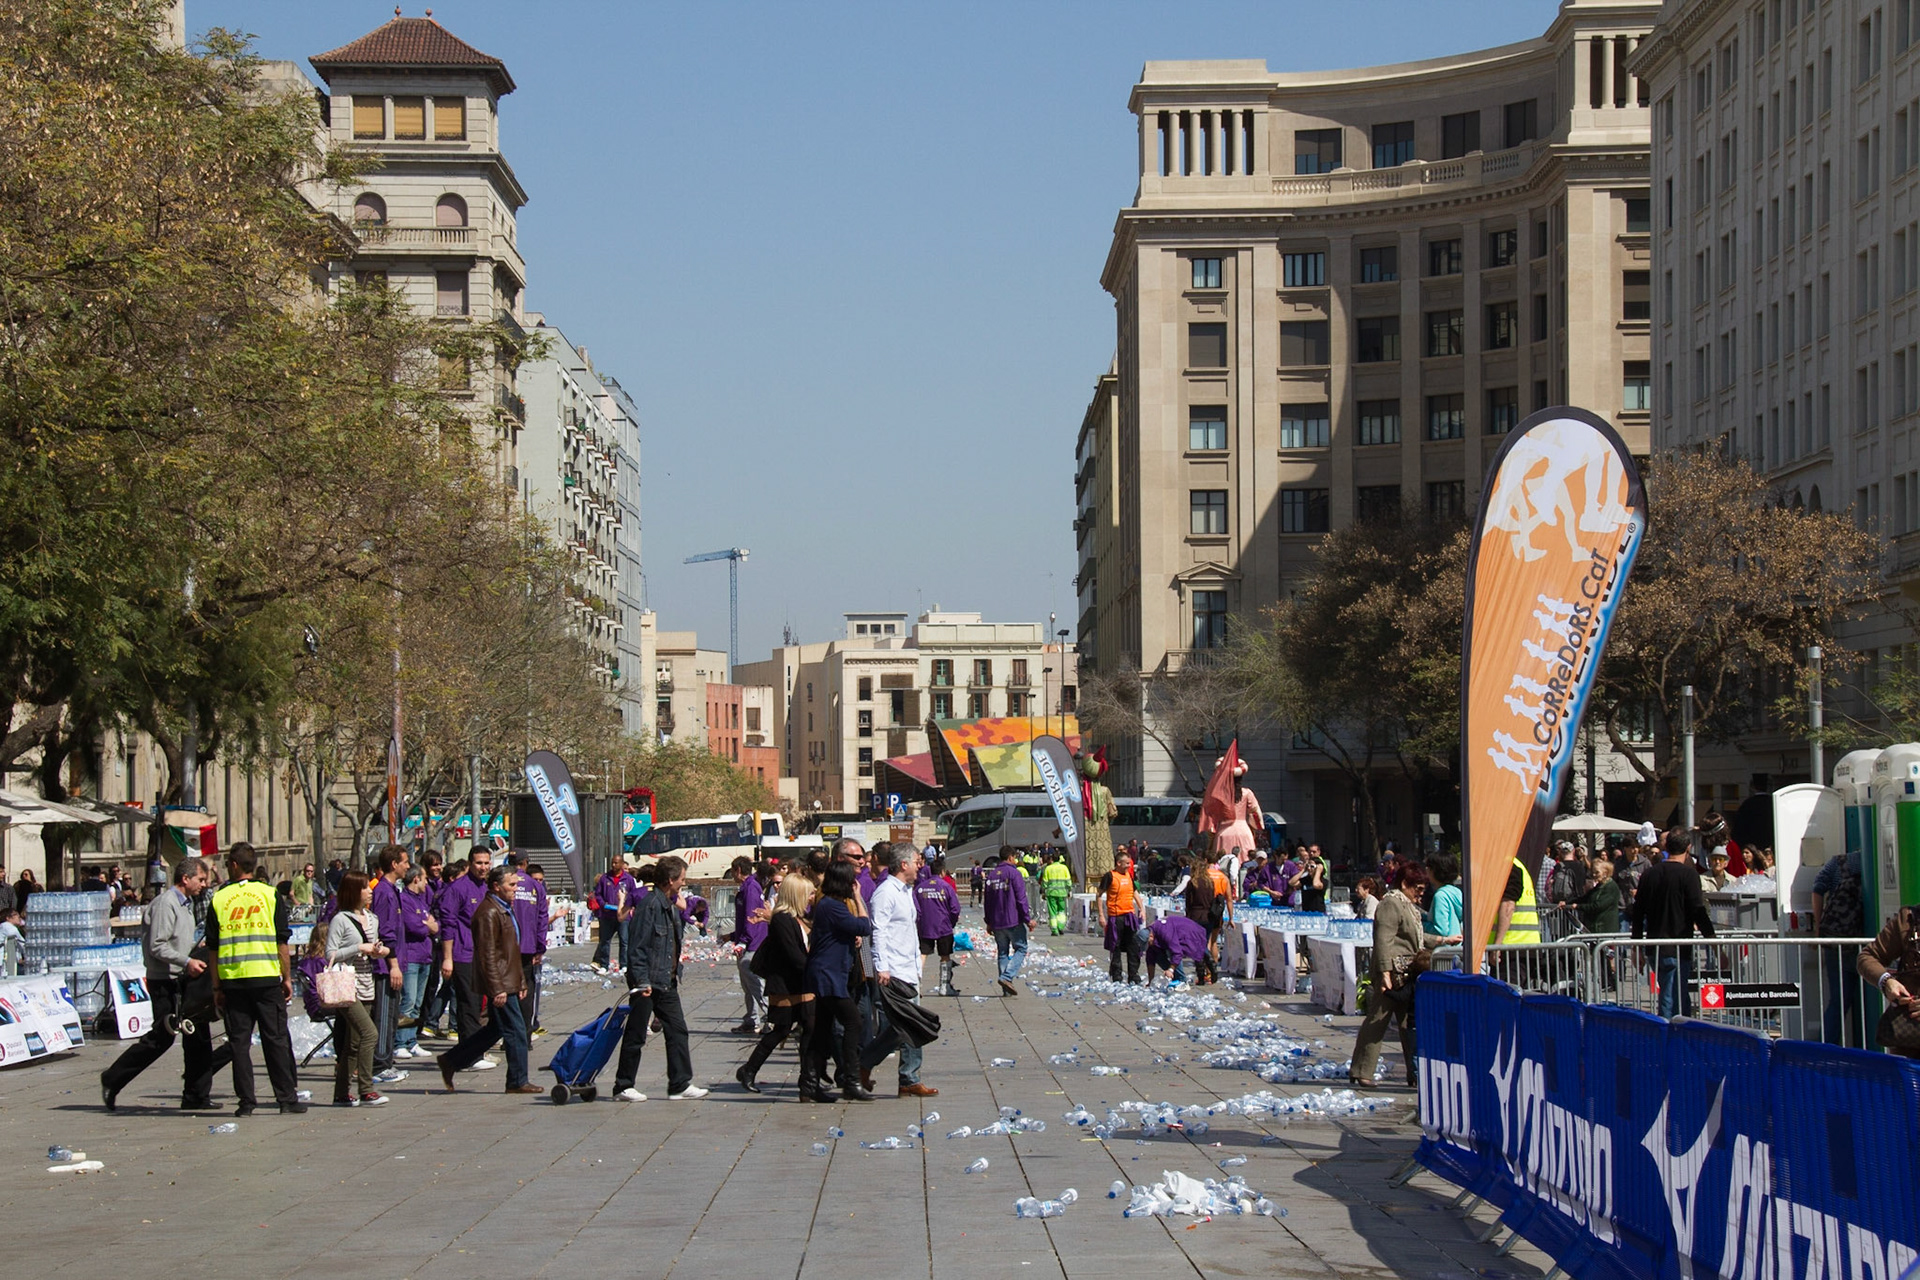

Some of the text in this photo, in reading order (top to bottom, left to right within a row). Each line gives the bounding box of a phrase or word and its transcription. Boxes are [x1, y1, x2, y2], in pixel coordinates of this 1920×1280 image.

[890, 794, 900, 808] P
[683, 849, 710, 865] Mir
[219, 921, 270, 932] CONTROL
[1725, 991, 1760, 1000] Ajuntament
